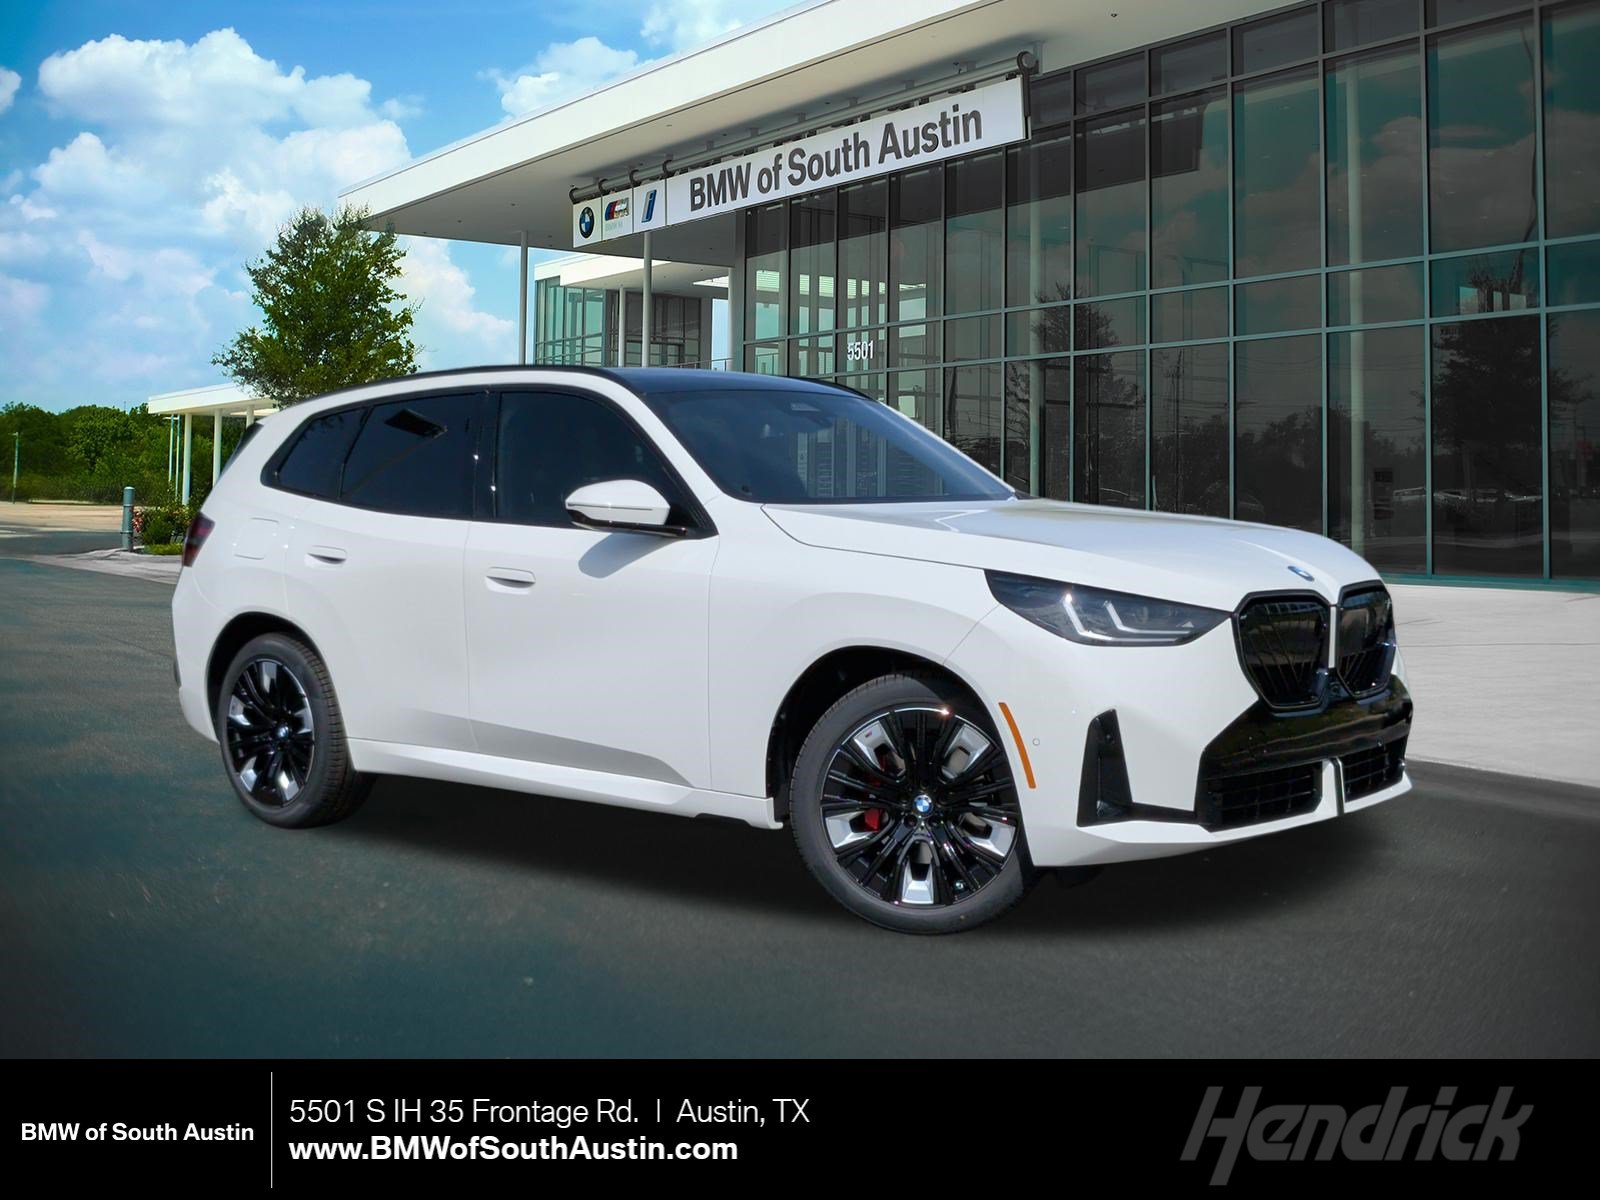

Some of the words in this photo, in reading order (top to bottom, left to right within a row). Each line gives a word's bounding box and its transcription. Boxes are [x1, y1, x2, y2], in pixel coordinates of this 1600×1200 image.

[690, 162, 751, 212] BMW
[757, 153, 783, 194] of
[787, 132, 870, 187] South
[878, 103, 983, 164] Austin
[847, 340, 874, 360] 5501
